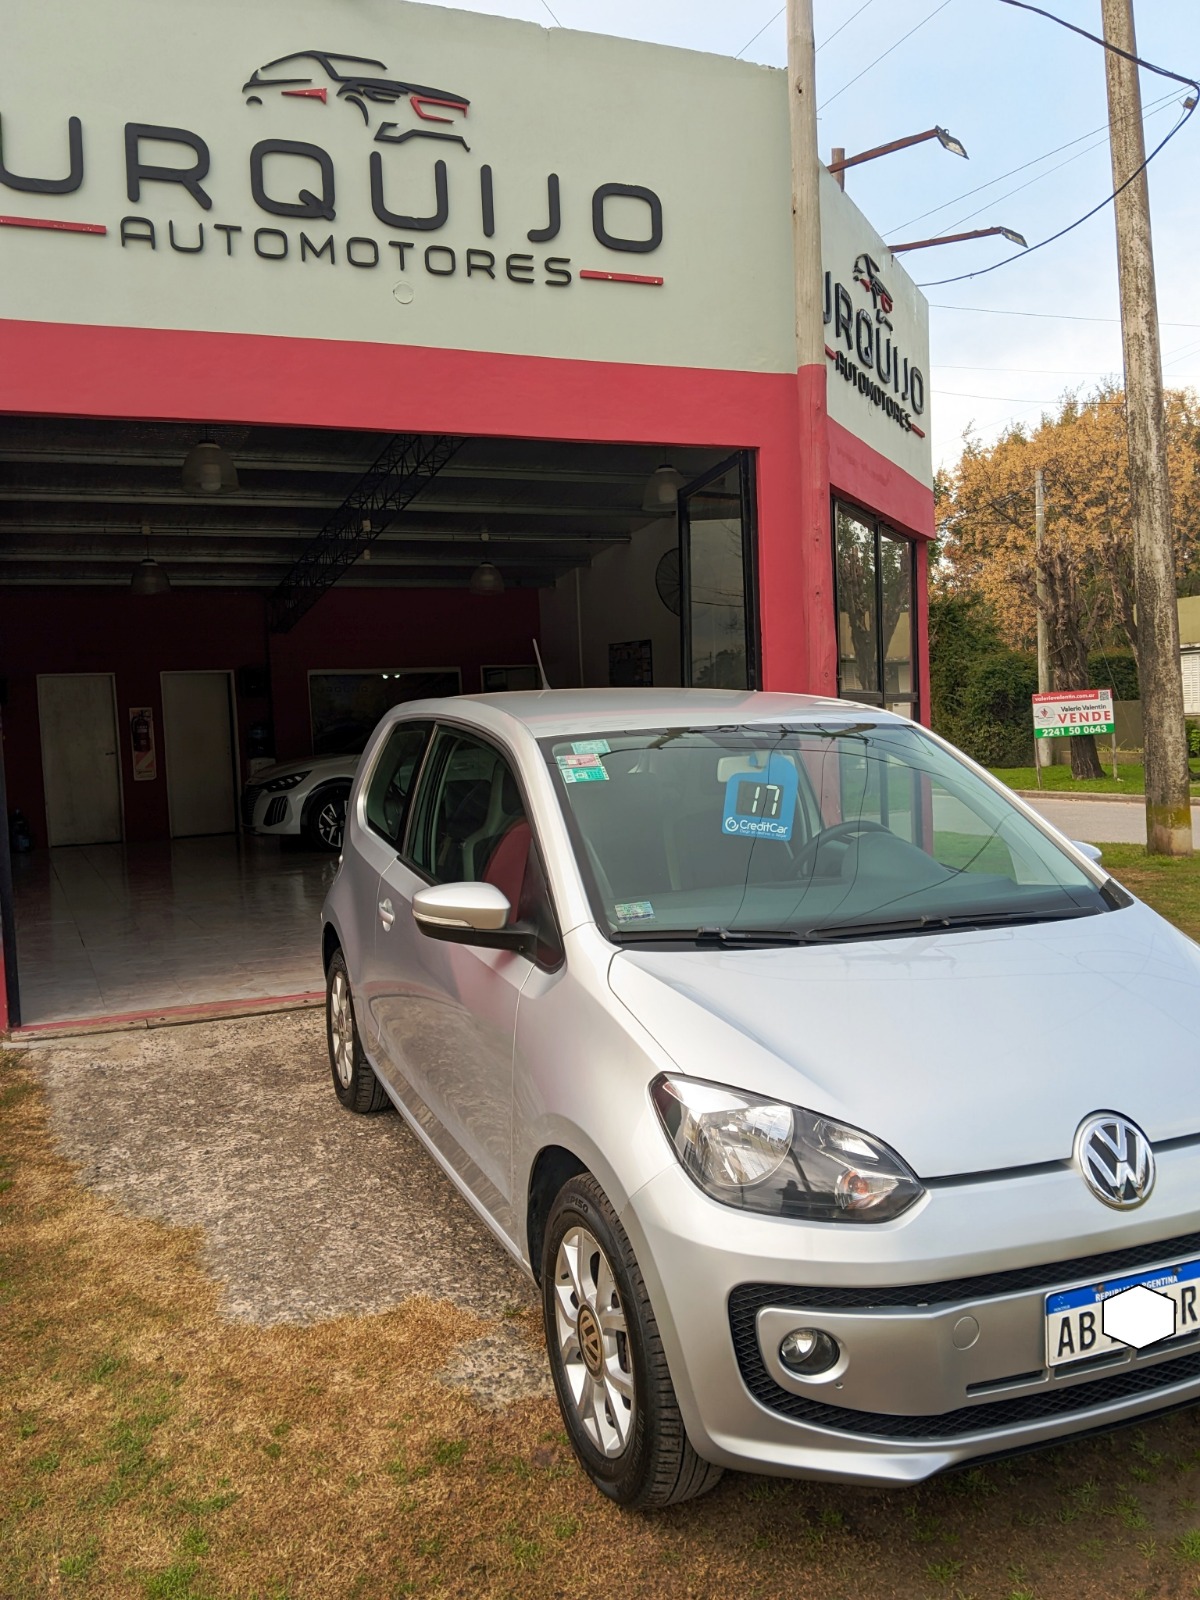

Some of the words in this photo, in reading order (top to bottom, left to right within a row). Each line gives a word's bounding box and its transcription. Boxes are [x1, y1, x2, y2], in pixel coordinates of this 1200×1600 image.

[0, 111, 663, 253] URQUIJO
[120, 216, 573, 286] AUTOMOTORES
[835, 350, 912, 432] AUTOMOTORES
[1042, 728, 1065, 737] 2241
[1069, 727, 1081, 735] 50
[1083, 725, 1107, 734] 0643
[1057, 710, 1111, 724] VENDE
[751, 784, 780, 816] 17
[739, 819, 788, 834] CreditCar
[1139, 1275, 1178, 1290] RGENTINA
[1057, 1311, 1097, 1357] AB
